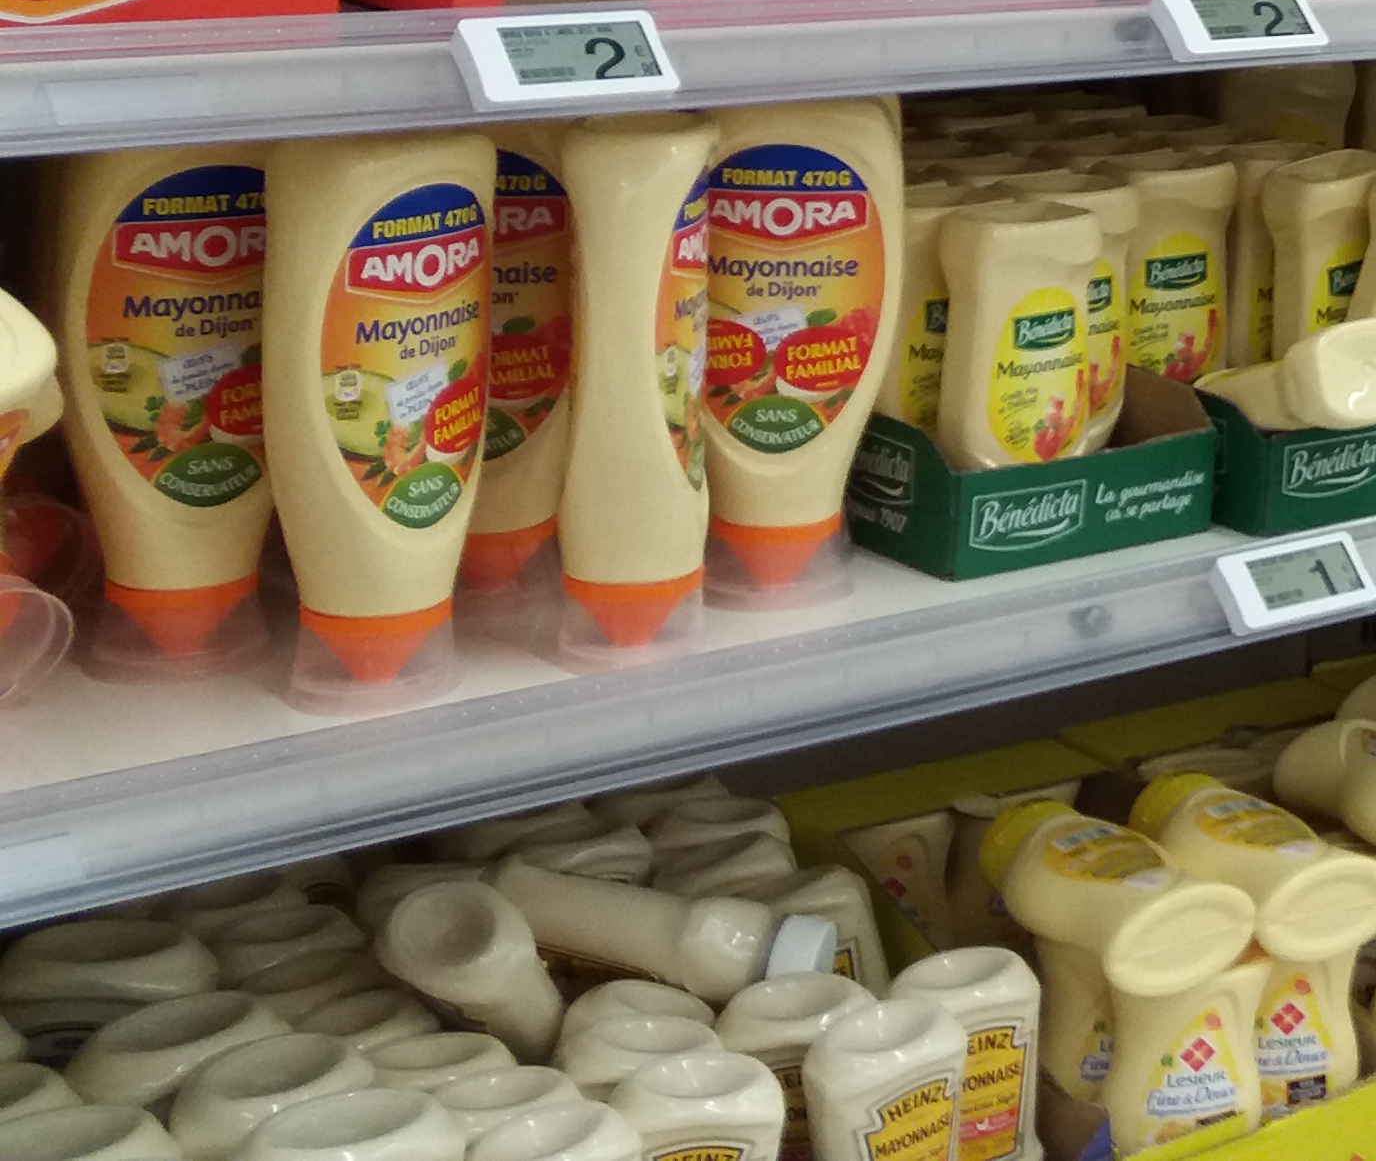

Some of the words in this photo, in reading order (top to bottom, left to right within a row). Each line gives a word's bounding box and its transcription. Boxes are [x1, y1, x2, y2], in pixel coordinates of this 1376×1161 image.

[584, 37, 625, 81] 2
[722, 168, 798, 187] FORMAT
[373, 215, 441, 240] FORMAT
[361, 239, 480, 286] AMORA
[1149, 255, 1206, 283] Bénédicta
[745, 284, 764, 297] de
[767, 281, 818, 300] Dijon
[1130, 294, 1216, 316] Mayonnaise
[175, 323, 196, 338] de
[200, 319, 253, 337] Dijon
[355, 301, 480, 345] Mayonnaise
[400, 346, 416, 360] de
[419, 337, 457, 358] Dijon
[787, 337, 857, 360] FORMAT
[785, 355, 861, 380] FAMILIAL
[434, 387, 480, 426] FORMAT
[755, 407, 799, 424] SANS
[186, 455, 233, 475] SANS
[408, 474, 444, 499] SANS
[1095, 484, 1108, 504] La
[1113, 471, 1206, 501] gourmandise
[978, 491, 1080, 538] Bénédicta
[1308, 558, 1338, 595] 1
[888, 1078, 946, 1122] HEINZ
